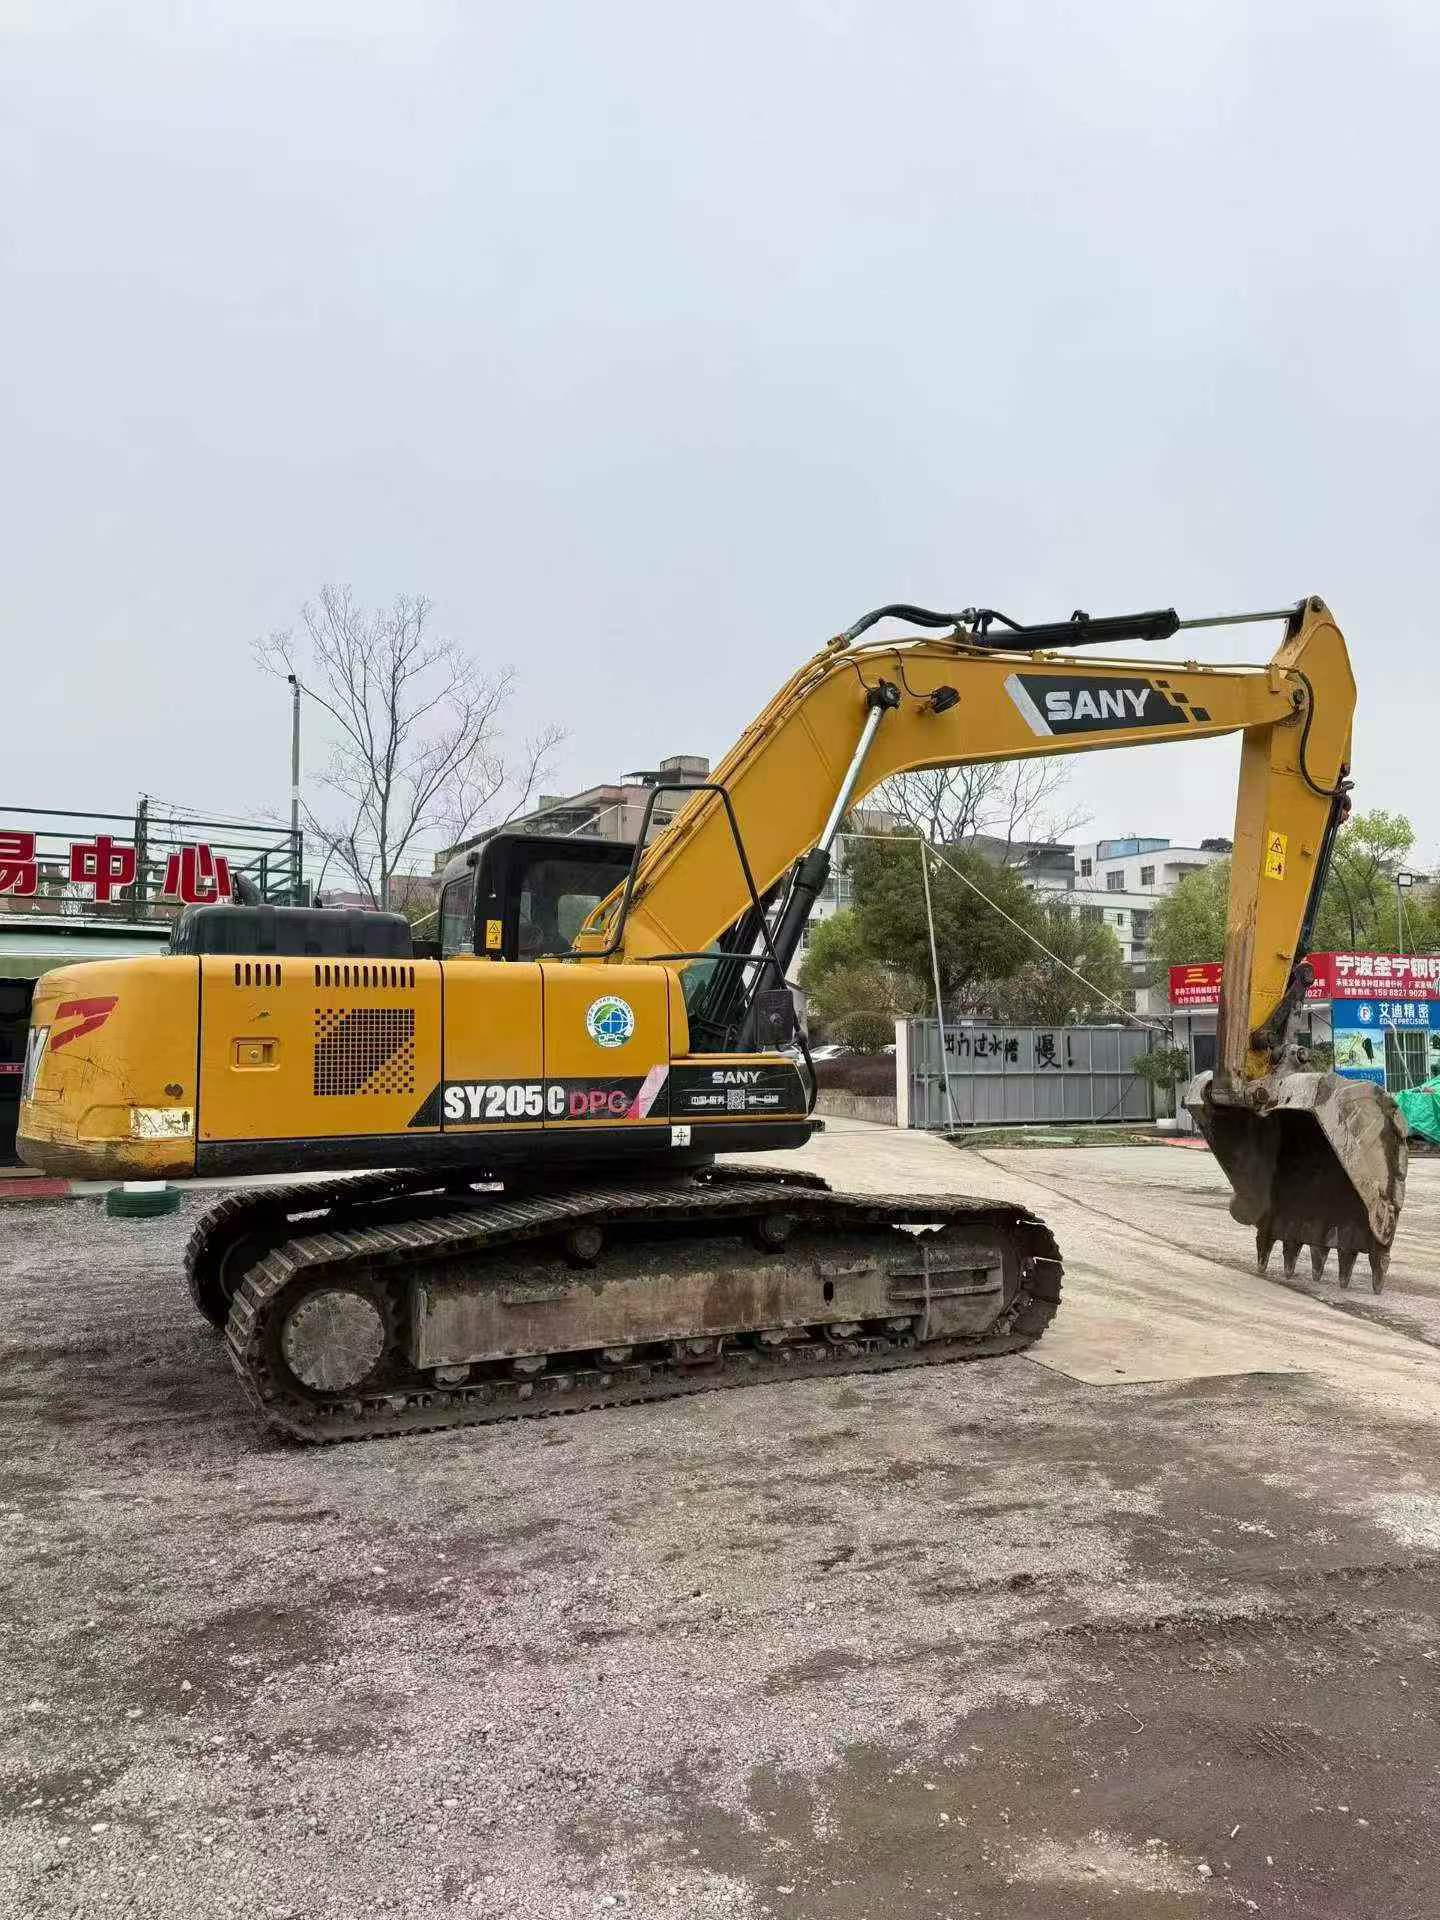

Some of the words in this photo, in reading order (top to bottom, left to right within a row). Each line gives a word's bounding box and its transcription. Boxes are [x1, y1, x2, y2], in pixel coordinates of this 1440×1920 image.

[1045, 688, 1150, 720] SANY
[1378, 1002, 1430, 1019] 艾迪精密
[712, 1071, 761, 1084] SANY
